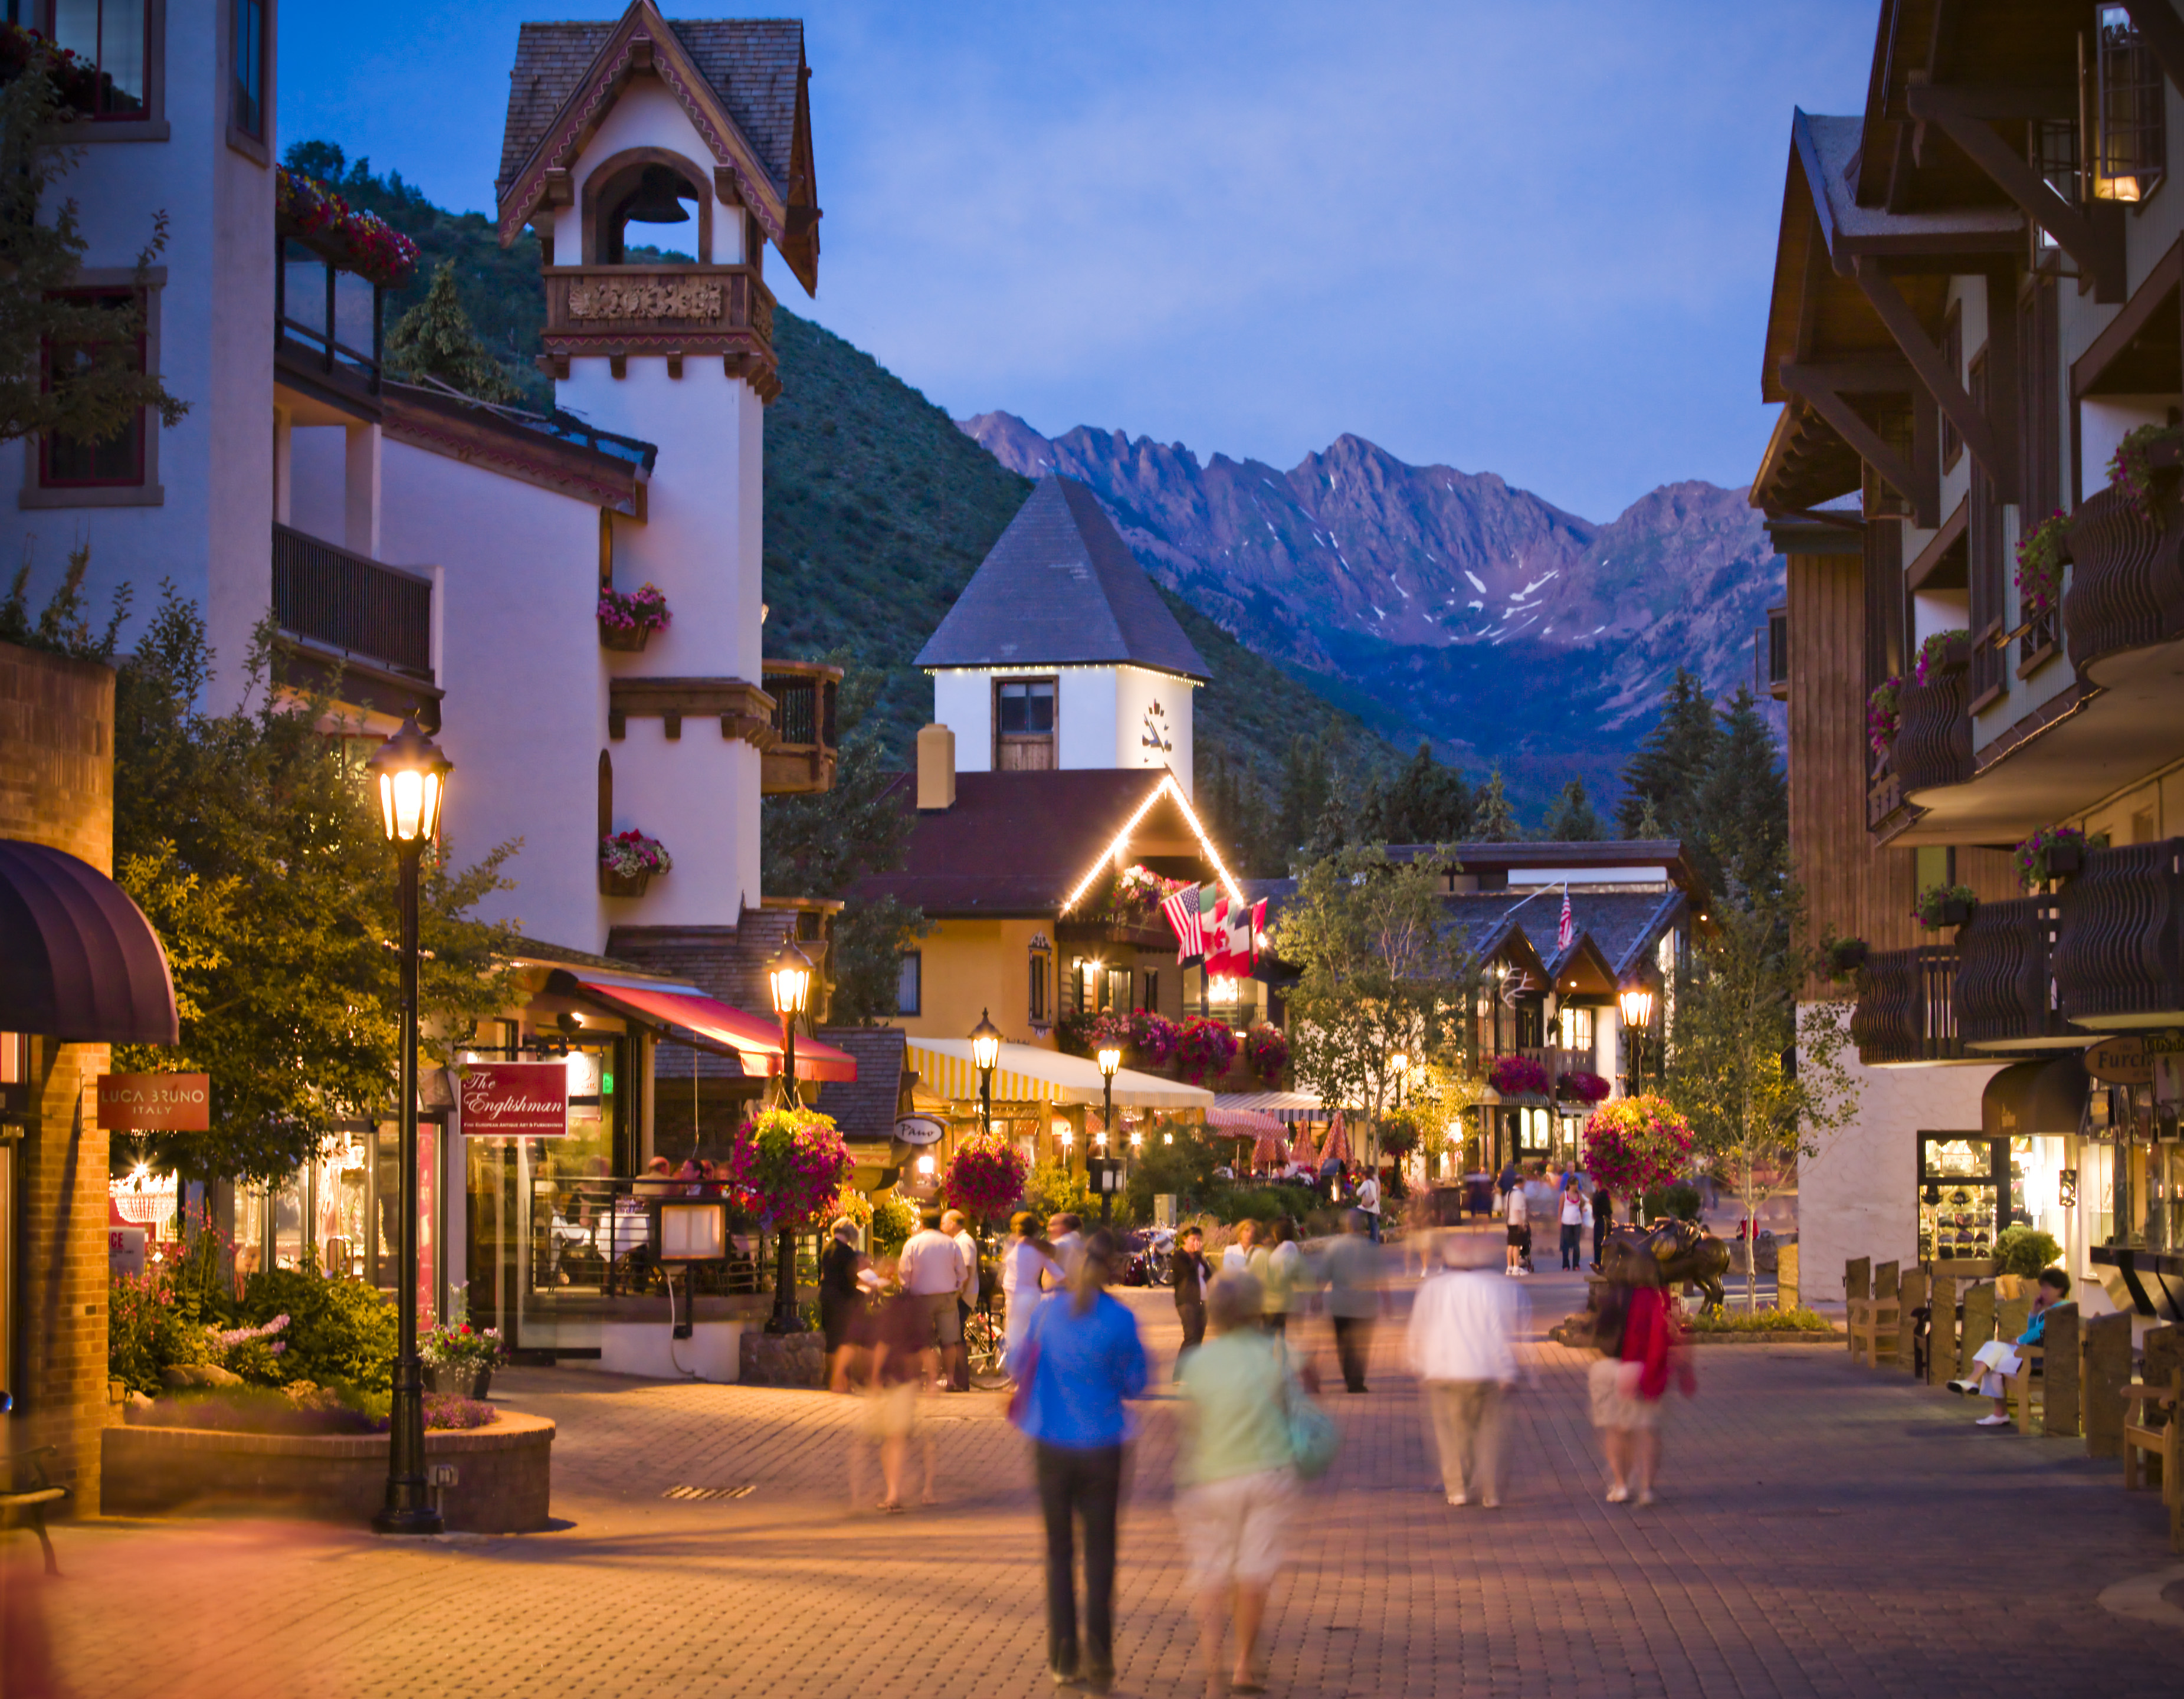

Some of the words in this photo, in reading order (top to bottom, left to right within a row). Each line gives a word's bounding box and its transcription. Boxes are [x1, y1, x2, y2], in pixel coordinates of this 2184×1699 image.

[463, 1071, 496, 1090] The
[101, 1090, 144, 1103] LUCA
[152, 1090, 204, 1103] BRUNO
[133, 1106, 172, 1114] ITALY
[464, 1092, 563, 1120] Englishman
